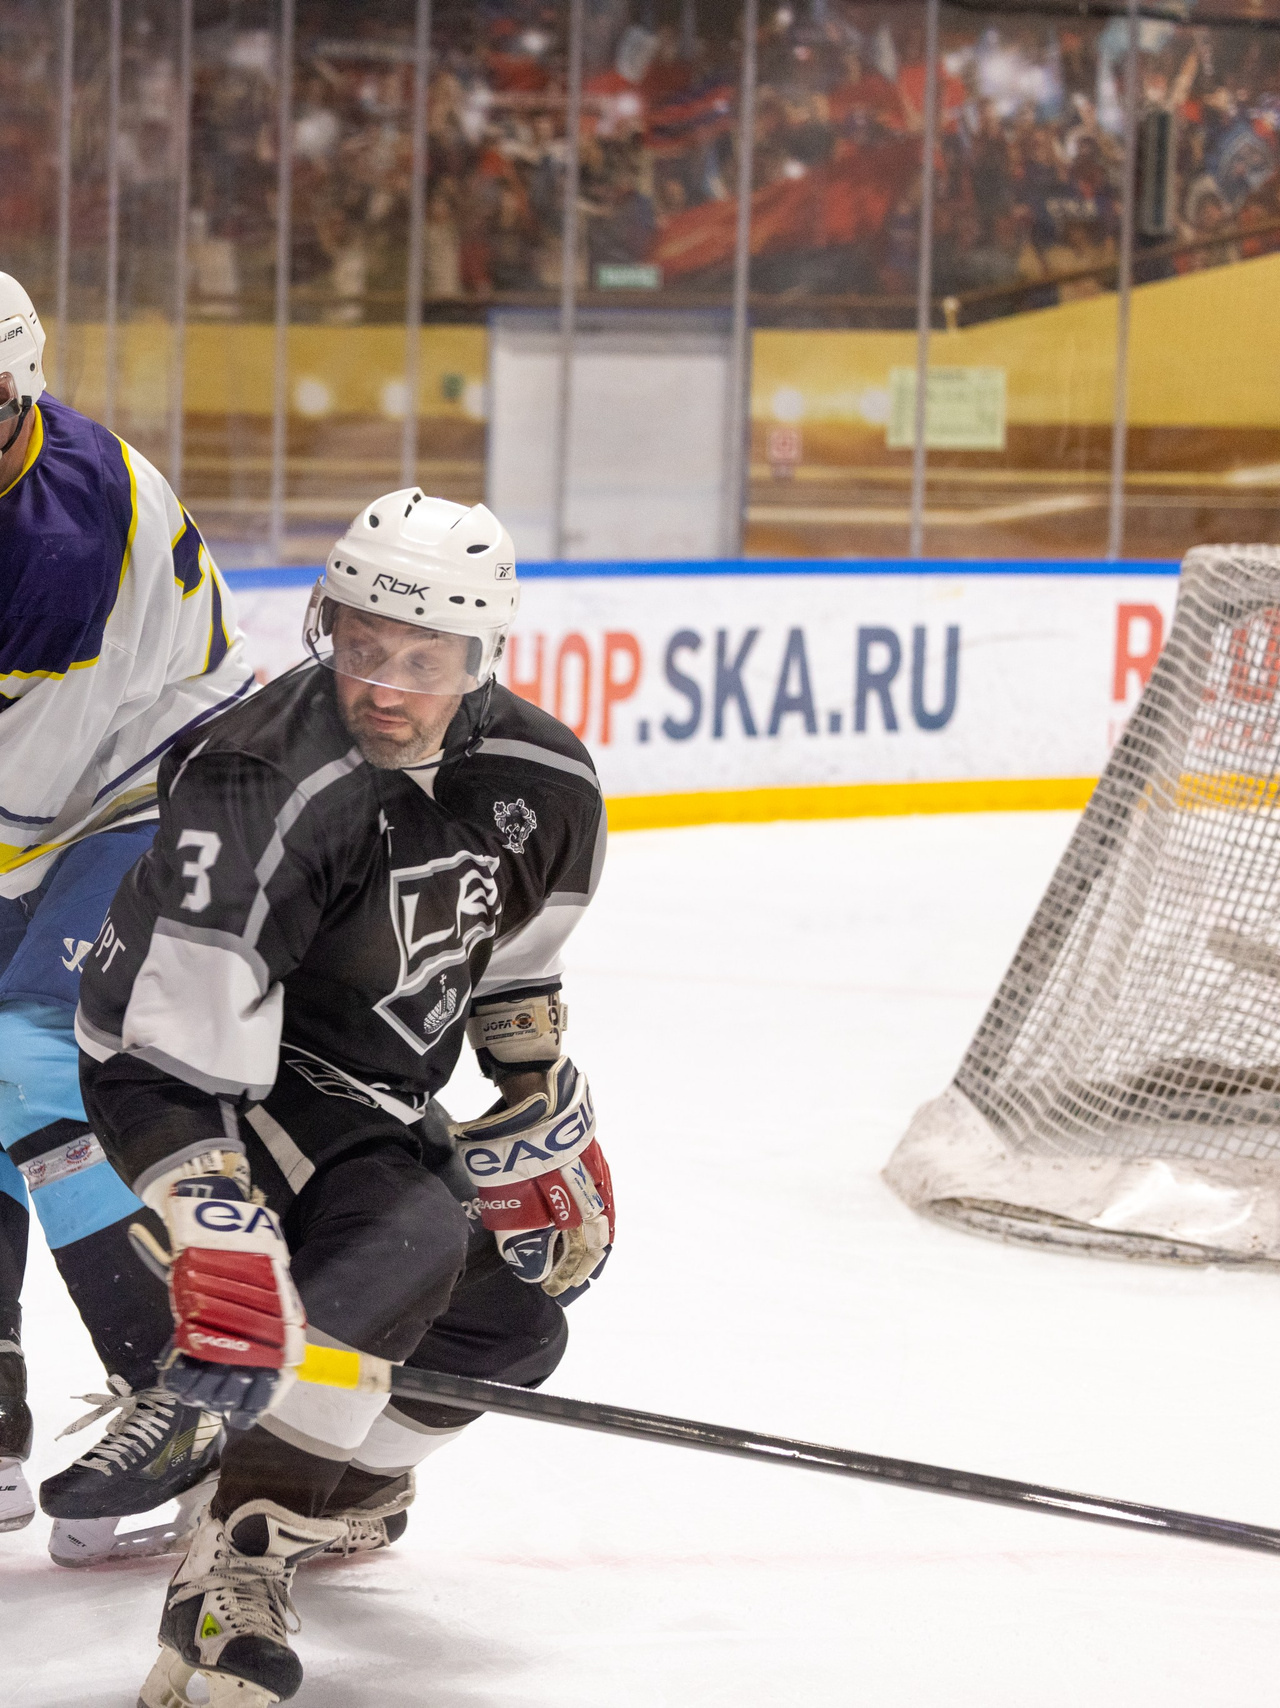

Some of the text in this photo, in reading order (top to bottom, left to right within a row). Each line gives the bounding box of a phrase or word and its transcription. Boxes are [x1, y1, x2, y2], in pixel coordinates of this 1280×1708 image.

[506, 624, 961, 746] HOP.SKA.RU
[177, 828, 222, 913] 3
[483, 1019, 513, 1032] JOFA
